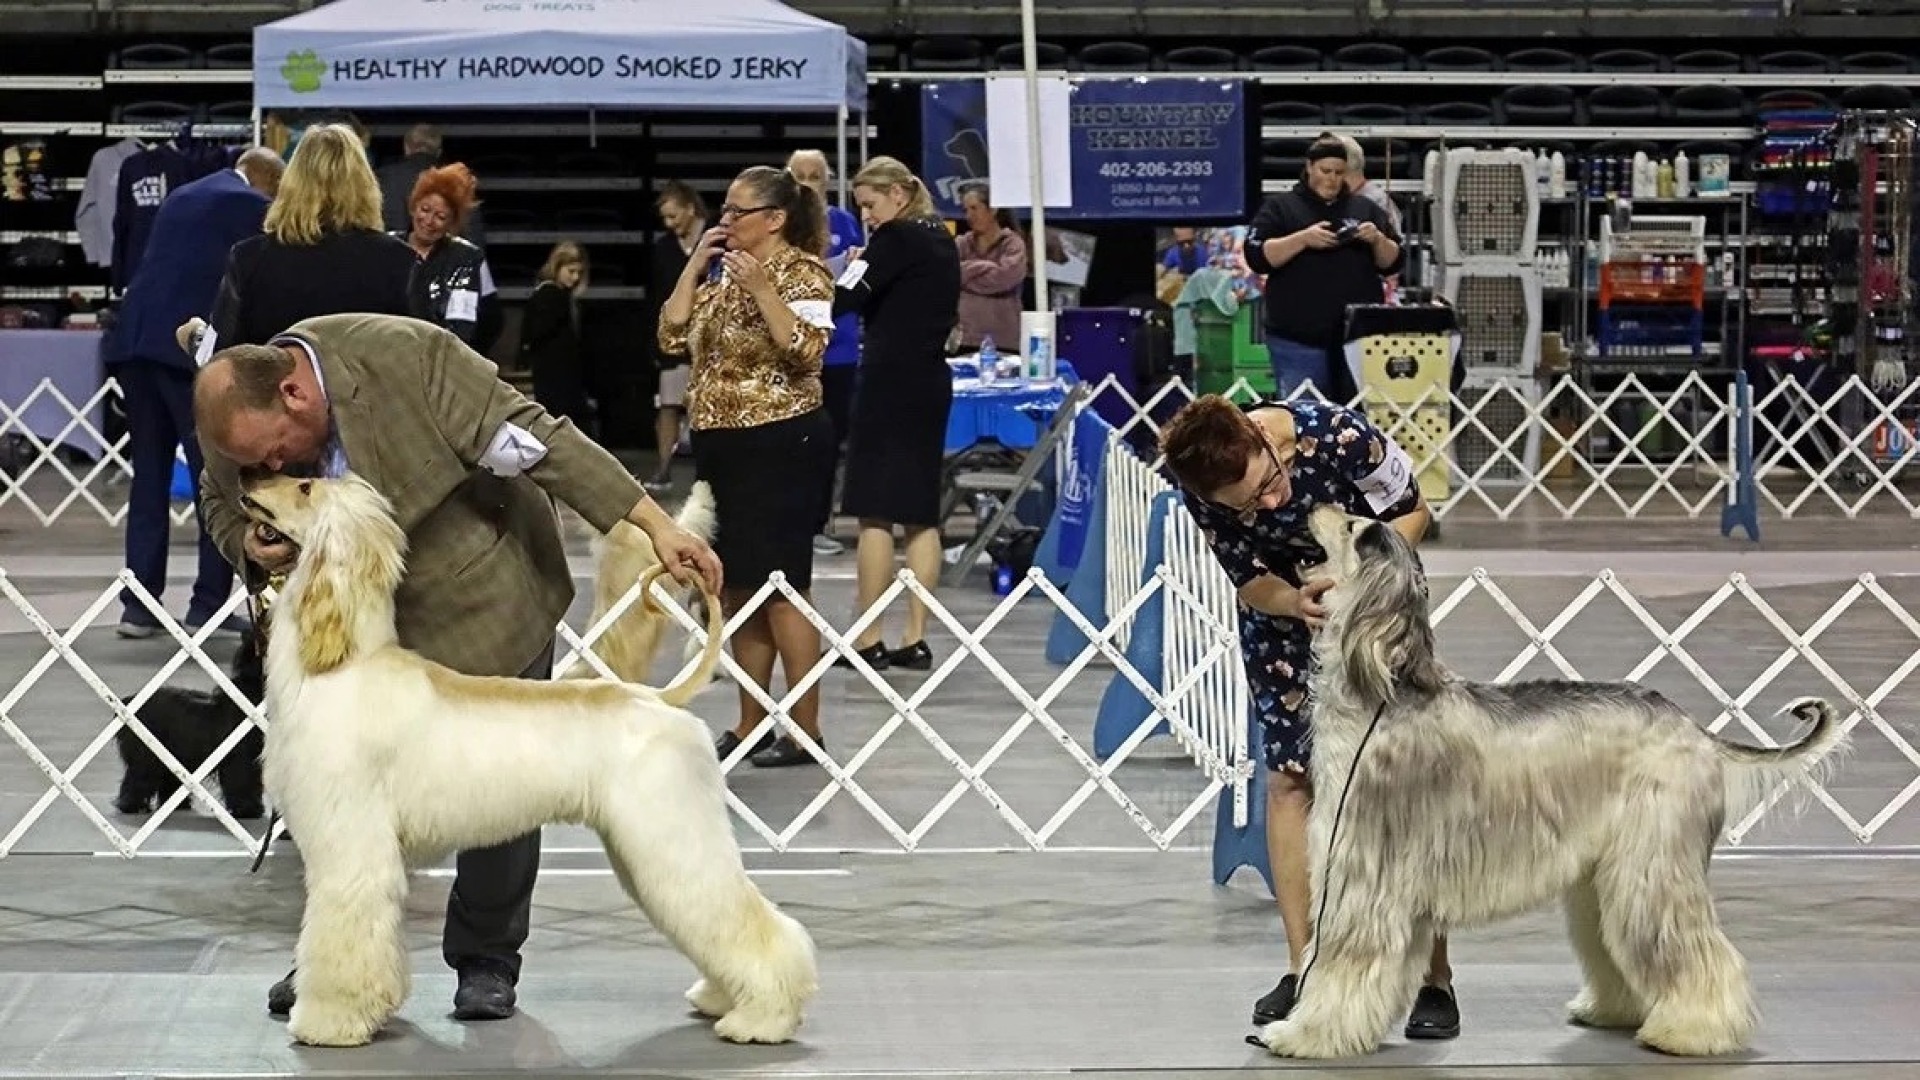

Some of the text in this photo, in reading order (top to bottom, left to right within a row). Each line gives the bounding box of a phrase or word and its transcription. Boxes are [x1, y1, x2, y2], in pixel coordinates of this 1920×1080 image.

[482, 3, 596, 12] DOG TREATS
[333, 54, 808, 81] HEALTHY HARDWOOD SMOKED JERKY
[1087, 127, 1220, 151] KENNEL
[1099, 161, 1213, 177] 402-206-2393
[1180, 183, 1201, 193] Ave
[1111, 196, 1150, 207] Council
[1187, 196, 1201, 206] IA
